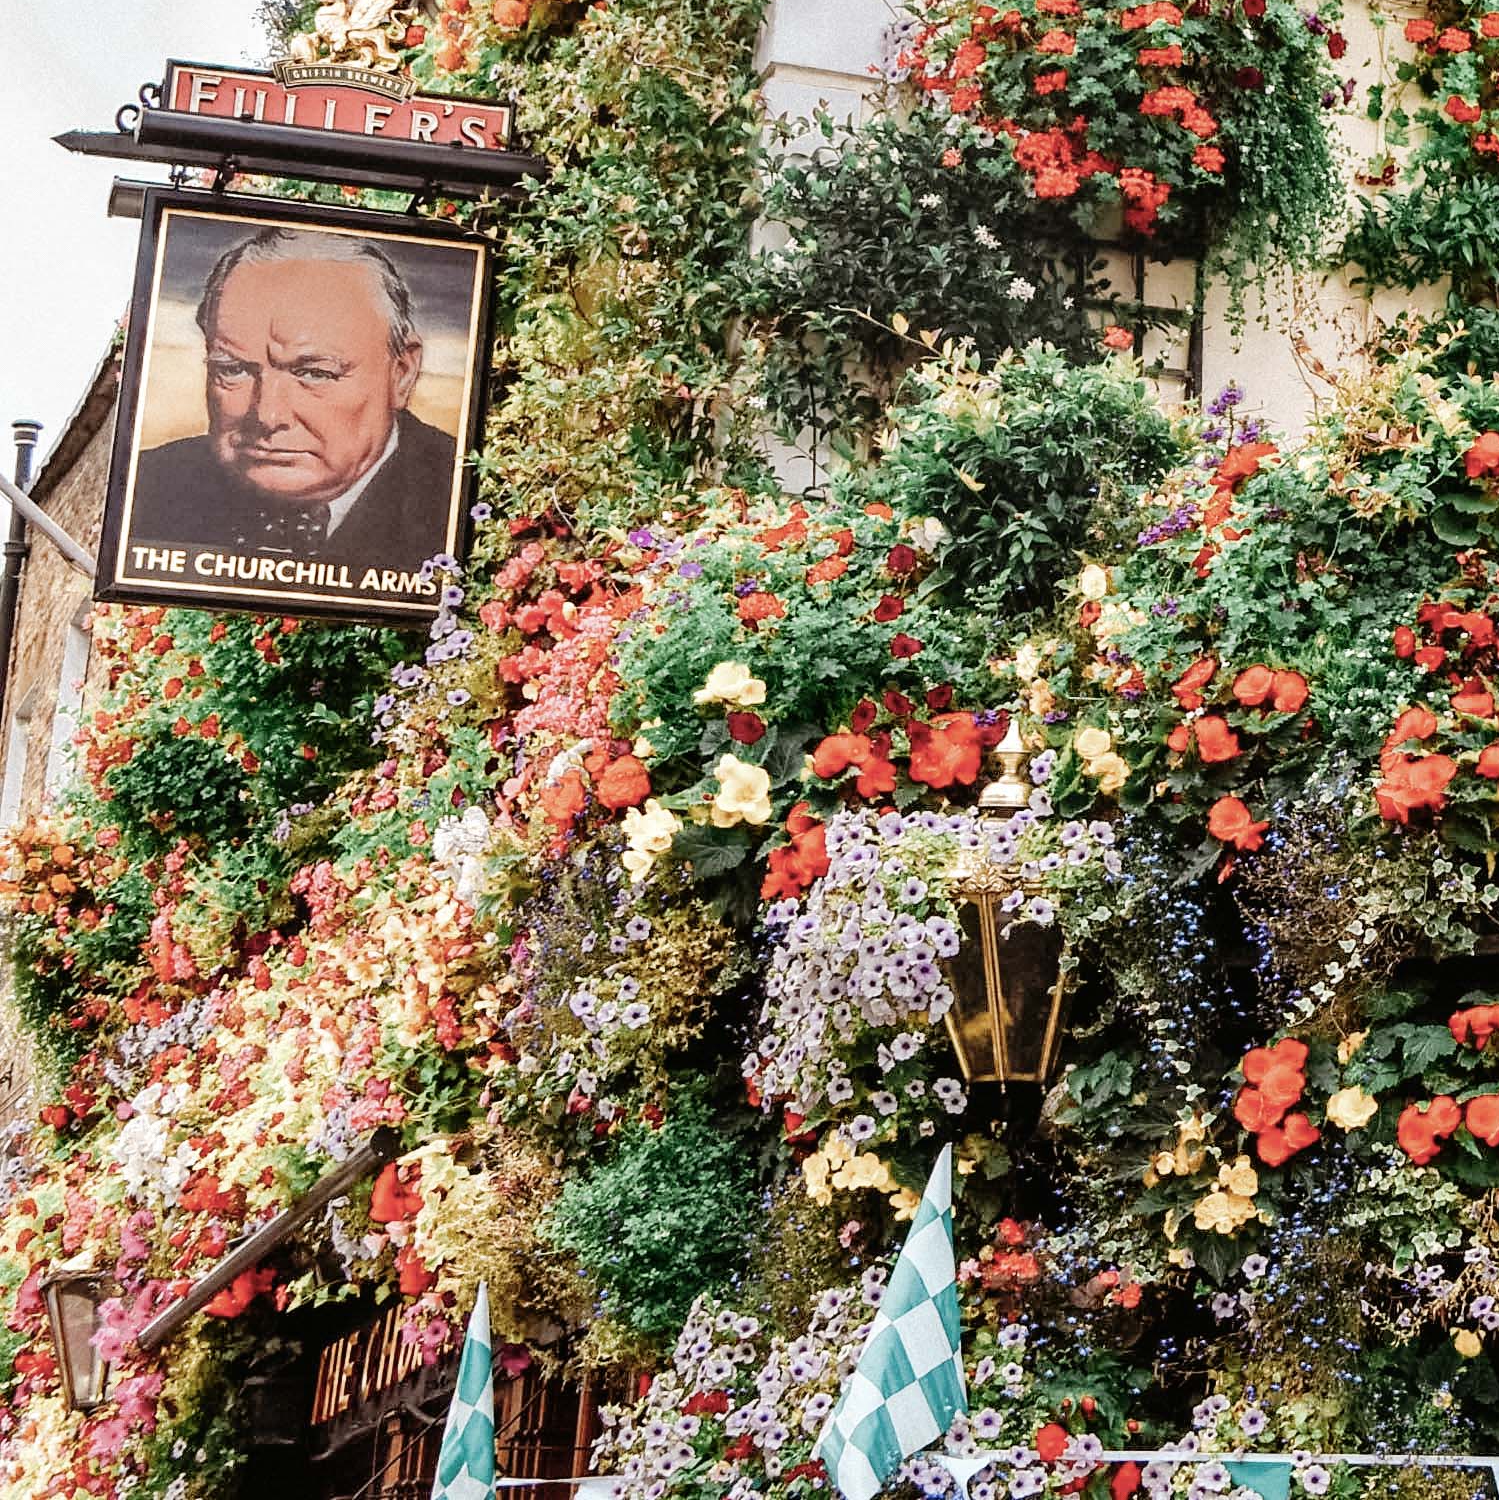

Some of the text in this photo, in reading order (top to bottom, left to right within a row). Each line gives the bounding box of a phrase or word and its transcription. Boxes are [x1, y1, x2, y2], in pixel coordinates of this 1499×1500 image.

[292, 67, 402, 90] GRIFFIN BREWERY
[131, 547, 437, 597] THE CHURCHILL ARMS
